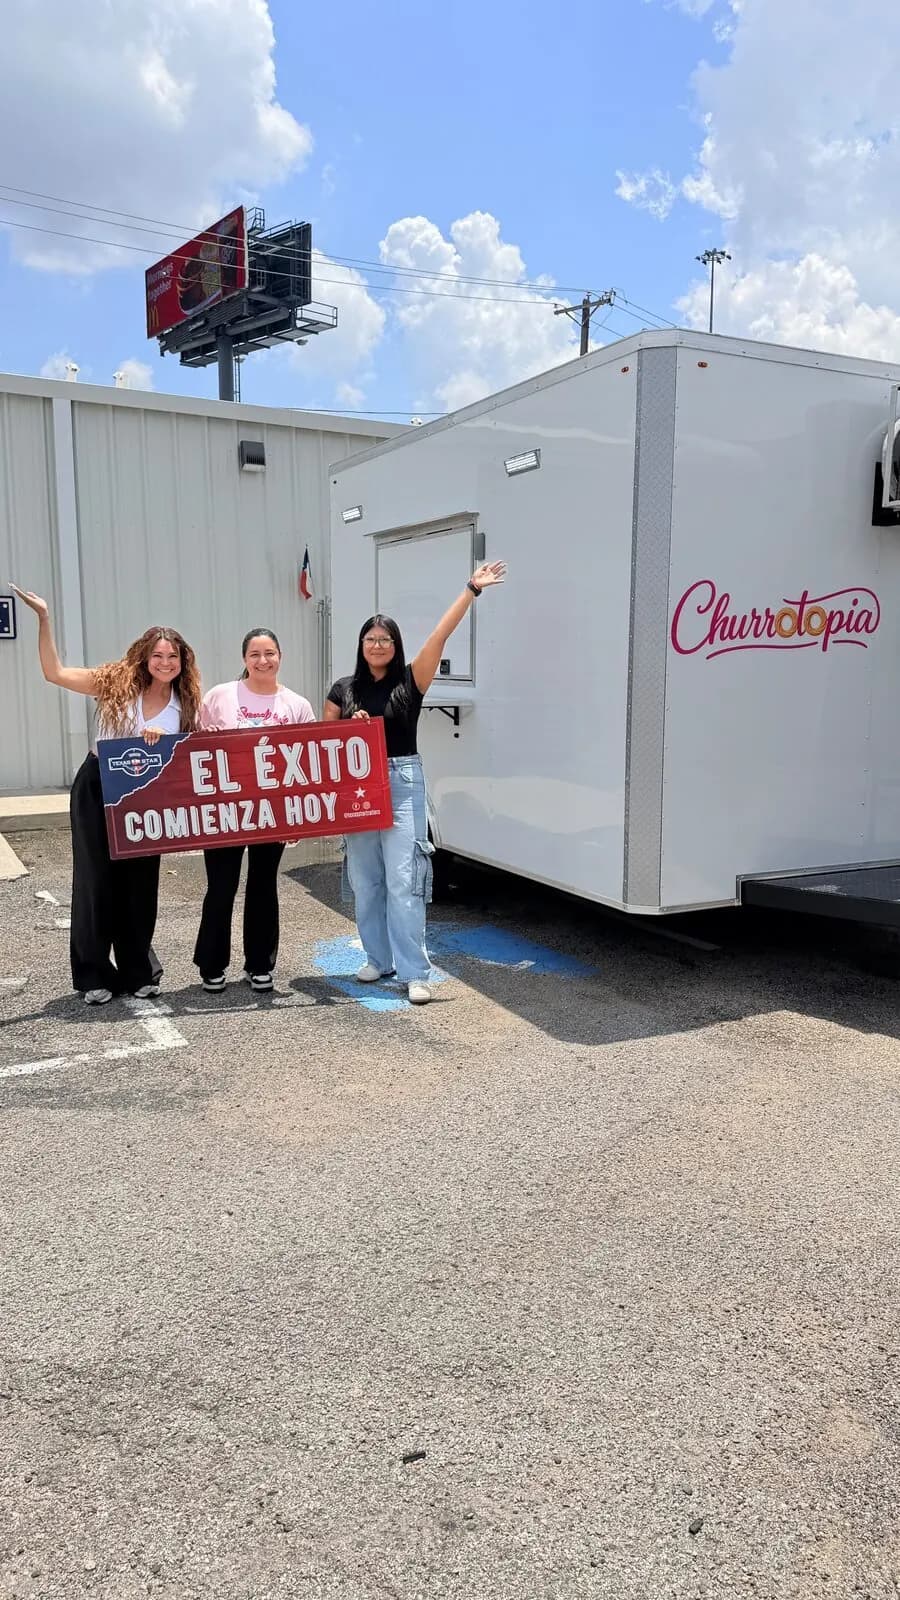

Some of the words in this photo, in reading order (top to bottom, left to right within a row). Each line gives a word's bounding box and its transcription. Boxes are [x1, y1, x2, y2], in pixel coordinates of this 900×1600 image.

[671, 580, 881, 659] Churrotopia
[189, 748, 242, 797] EL
[253, 736, 372, 790] ÉXITO
[124, 798, 277, 843] COMIENZA
[284, 791, 338, 826] HOY
